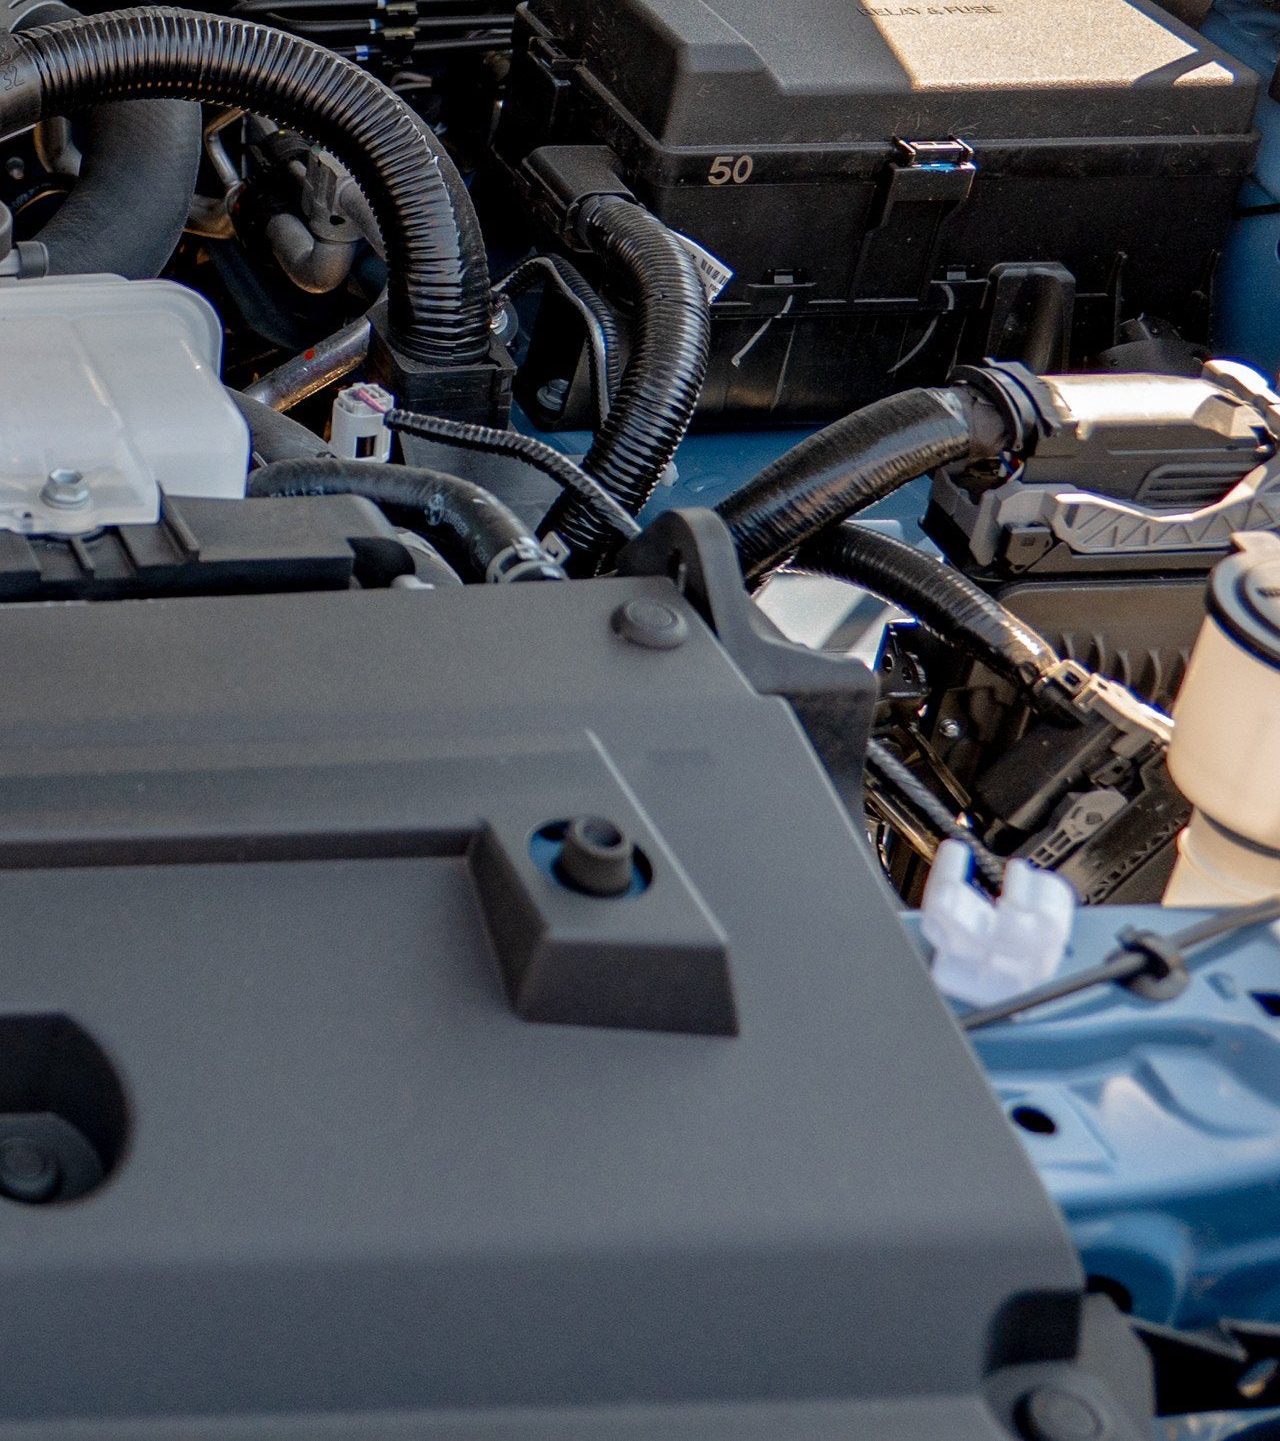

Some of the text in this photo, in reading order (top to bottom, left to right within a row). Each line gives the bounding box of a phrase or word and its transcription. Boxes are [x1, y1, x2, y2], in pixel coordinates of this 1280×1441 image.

[857, 5, 1002, 16] RELAY & FUSE
[707, 155, 753, 185] 50
